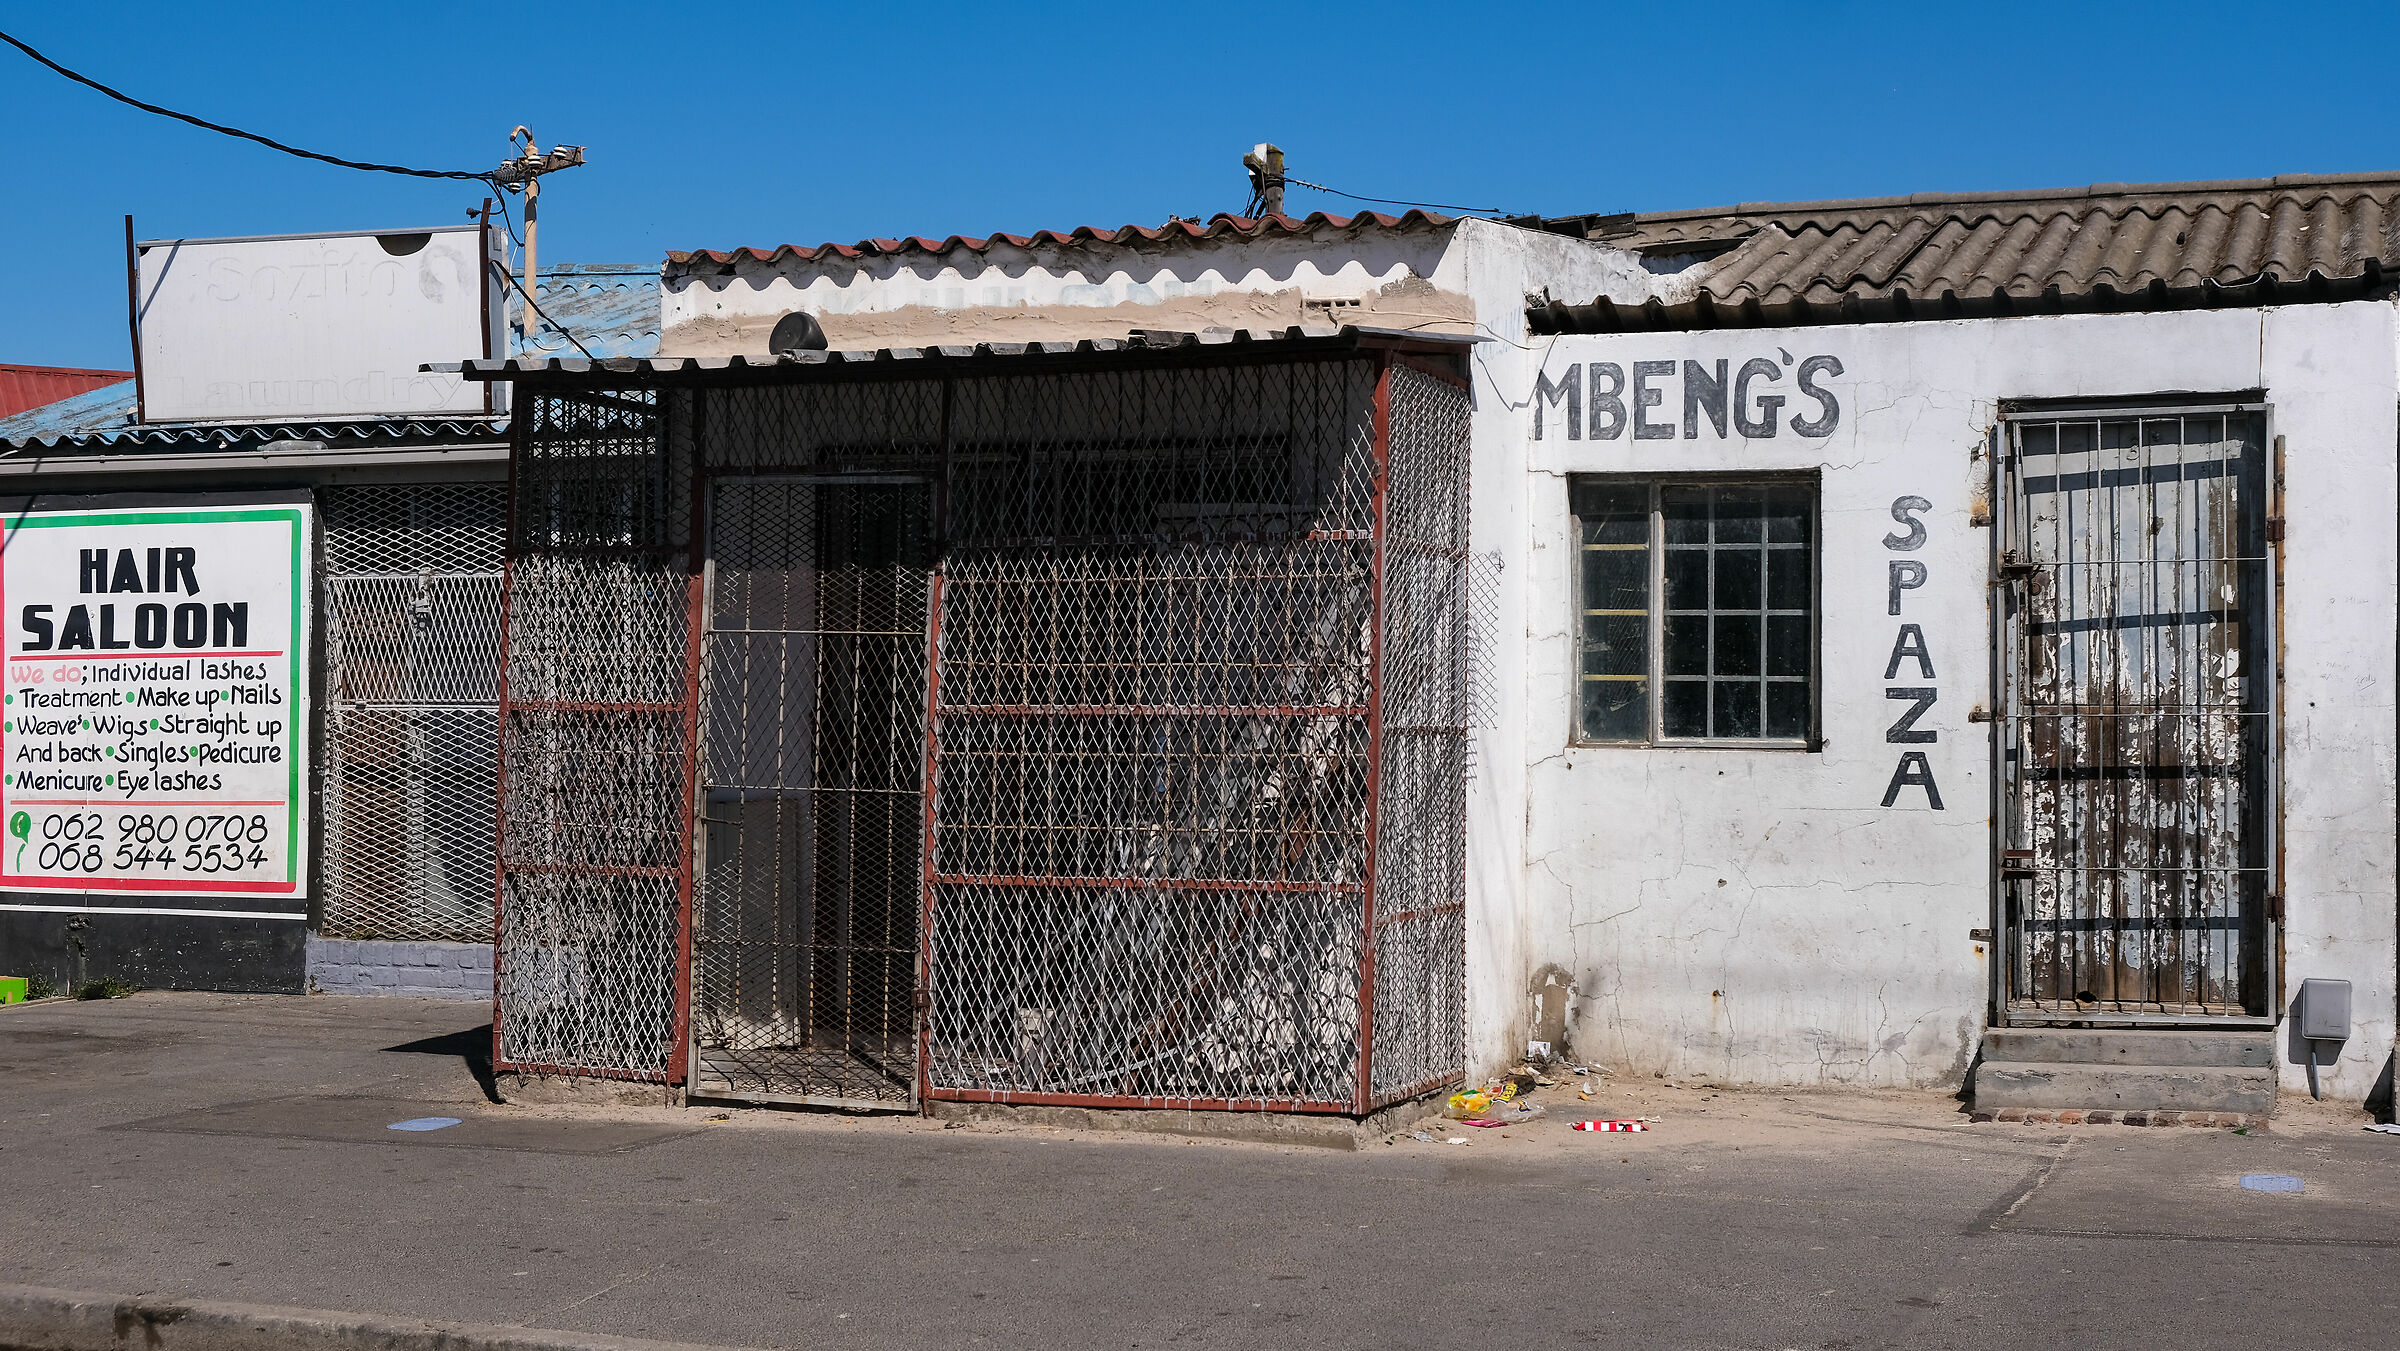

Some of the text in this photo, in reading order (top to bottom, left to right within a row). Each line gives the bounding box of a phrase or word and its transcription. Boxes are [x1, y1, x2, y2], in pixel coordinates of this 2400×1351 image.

[1534, 347, 1845, 441] MBENG'S
[80, 547, 200, 597] HAIR
[22, 602, 248, 651] SALOON
[1880, 495, 1945, 811] SPAZA
[11, 665, 45, 684] We
[93, 660, 190, 683] Individual
[201, 659, 267, 680] lashes
[19, 683, 282, 712] Treatment Make up Nails
[93, 715, 148, 742] Wigs
[160, 711, 249, 743] Straight
[257, 720, 282, 742] up
[16, 740, 282, 771] And back Singles Pedicure
[16, 769, 103, 792] Menicure
[43, 814, 268, 843] 062 980 0708
[39, 842, 268, 873] 068 544 5534
